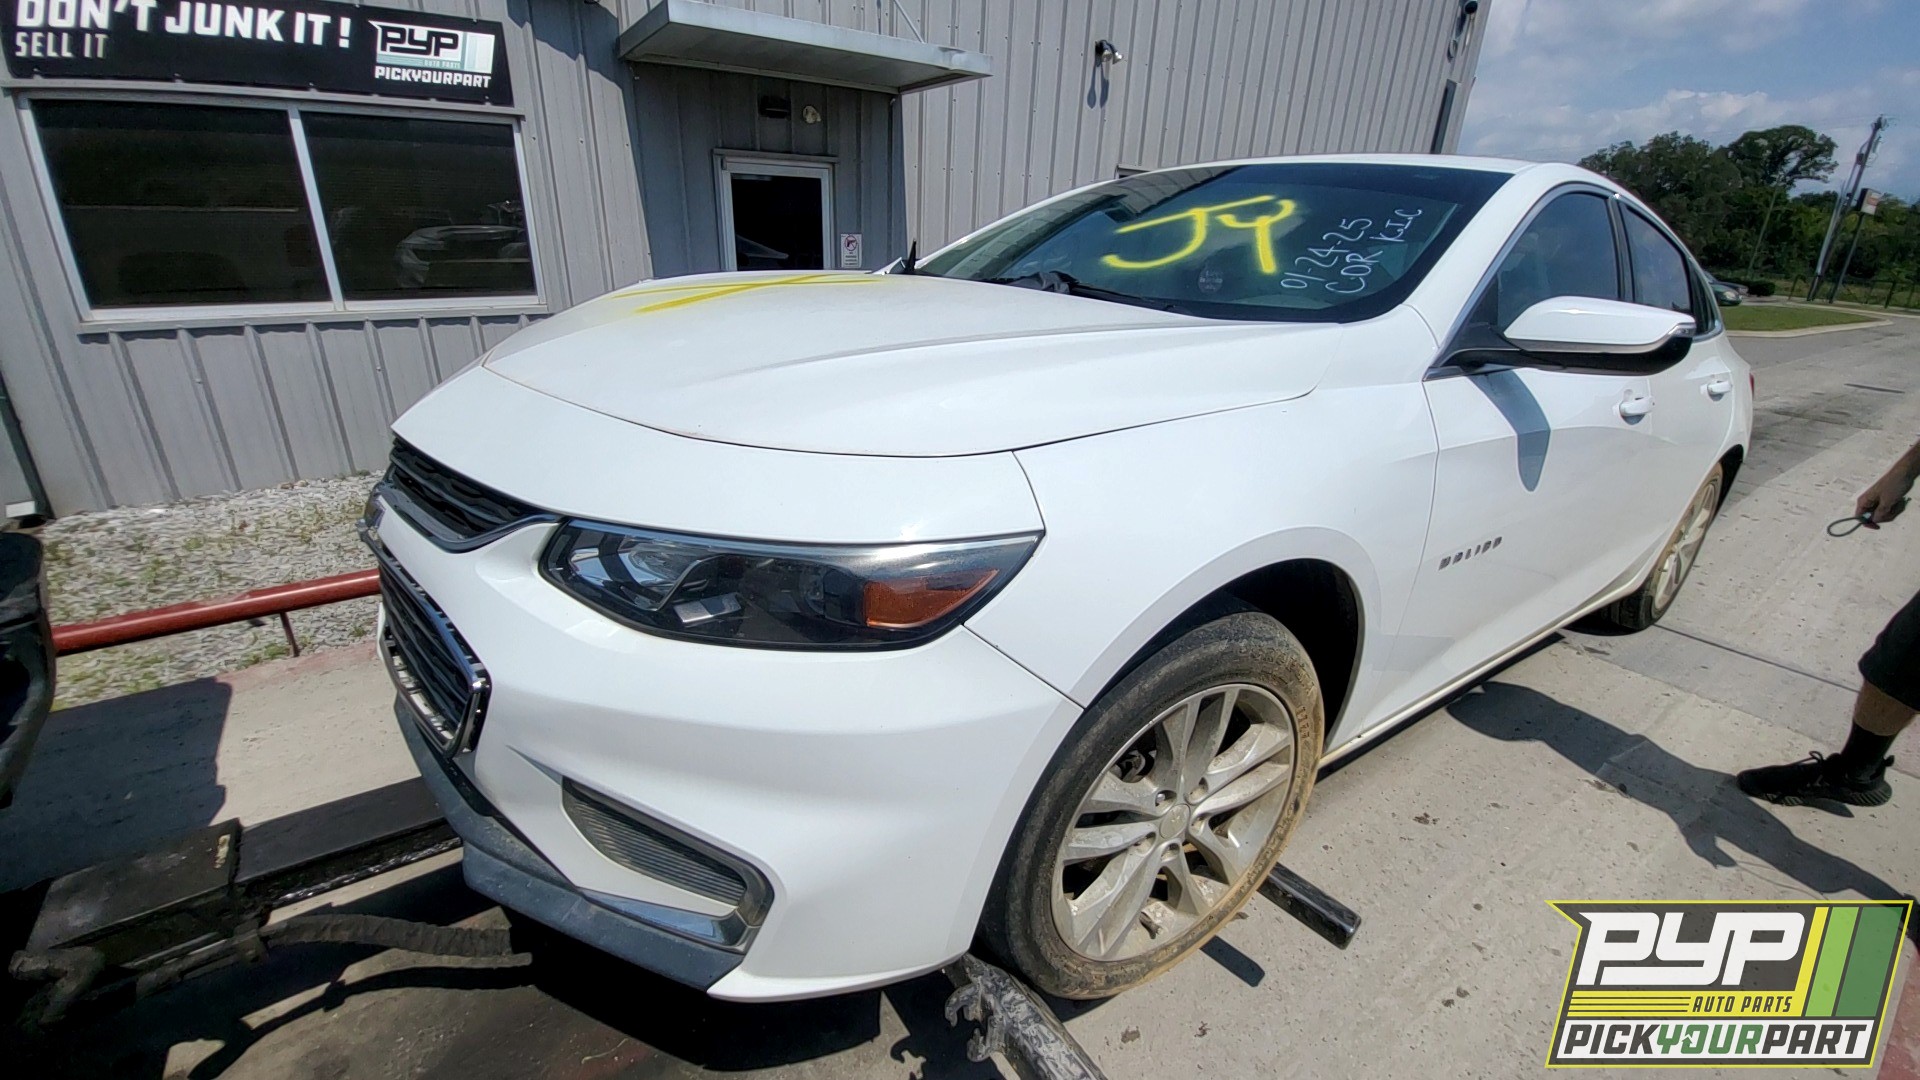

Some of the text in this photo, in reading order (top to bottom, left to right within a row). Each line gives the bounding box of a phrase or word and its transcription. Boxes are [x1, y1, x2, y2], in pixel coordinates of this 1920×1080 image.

[17, 0, 157, 32] DON'T
[165, 1, 285, 42] JUNK
[15, 31, 108, 58] SELL IT
[379, 25, 459, 57] PYP
[374, 65, 492, 88] PICKYOURPART
